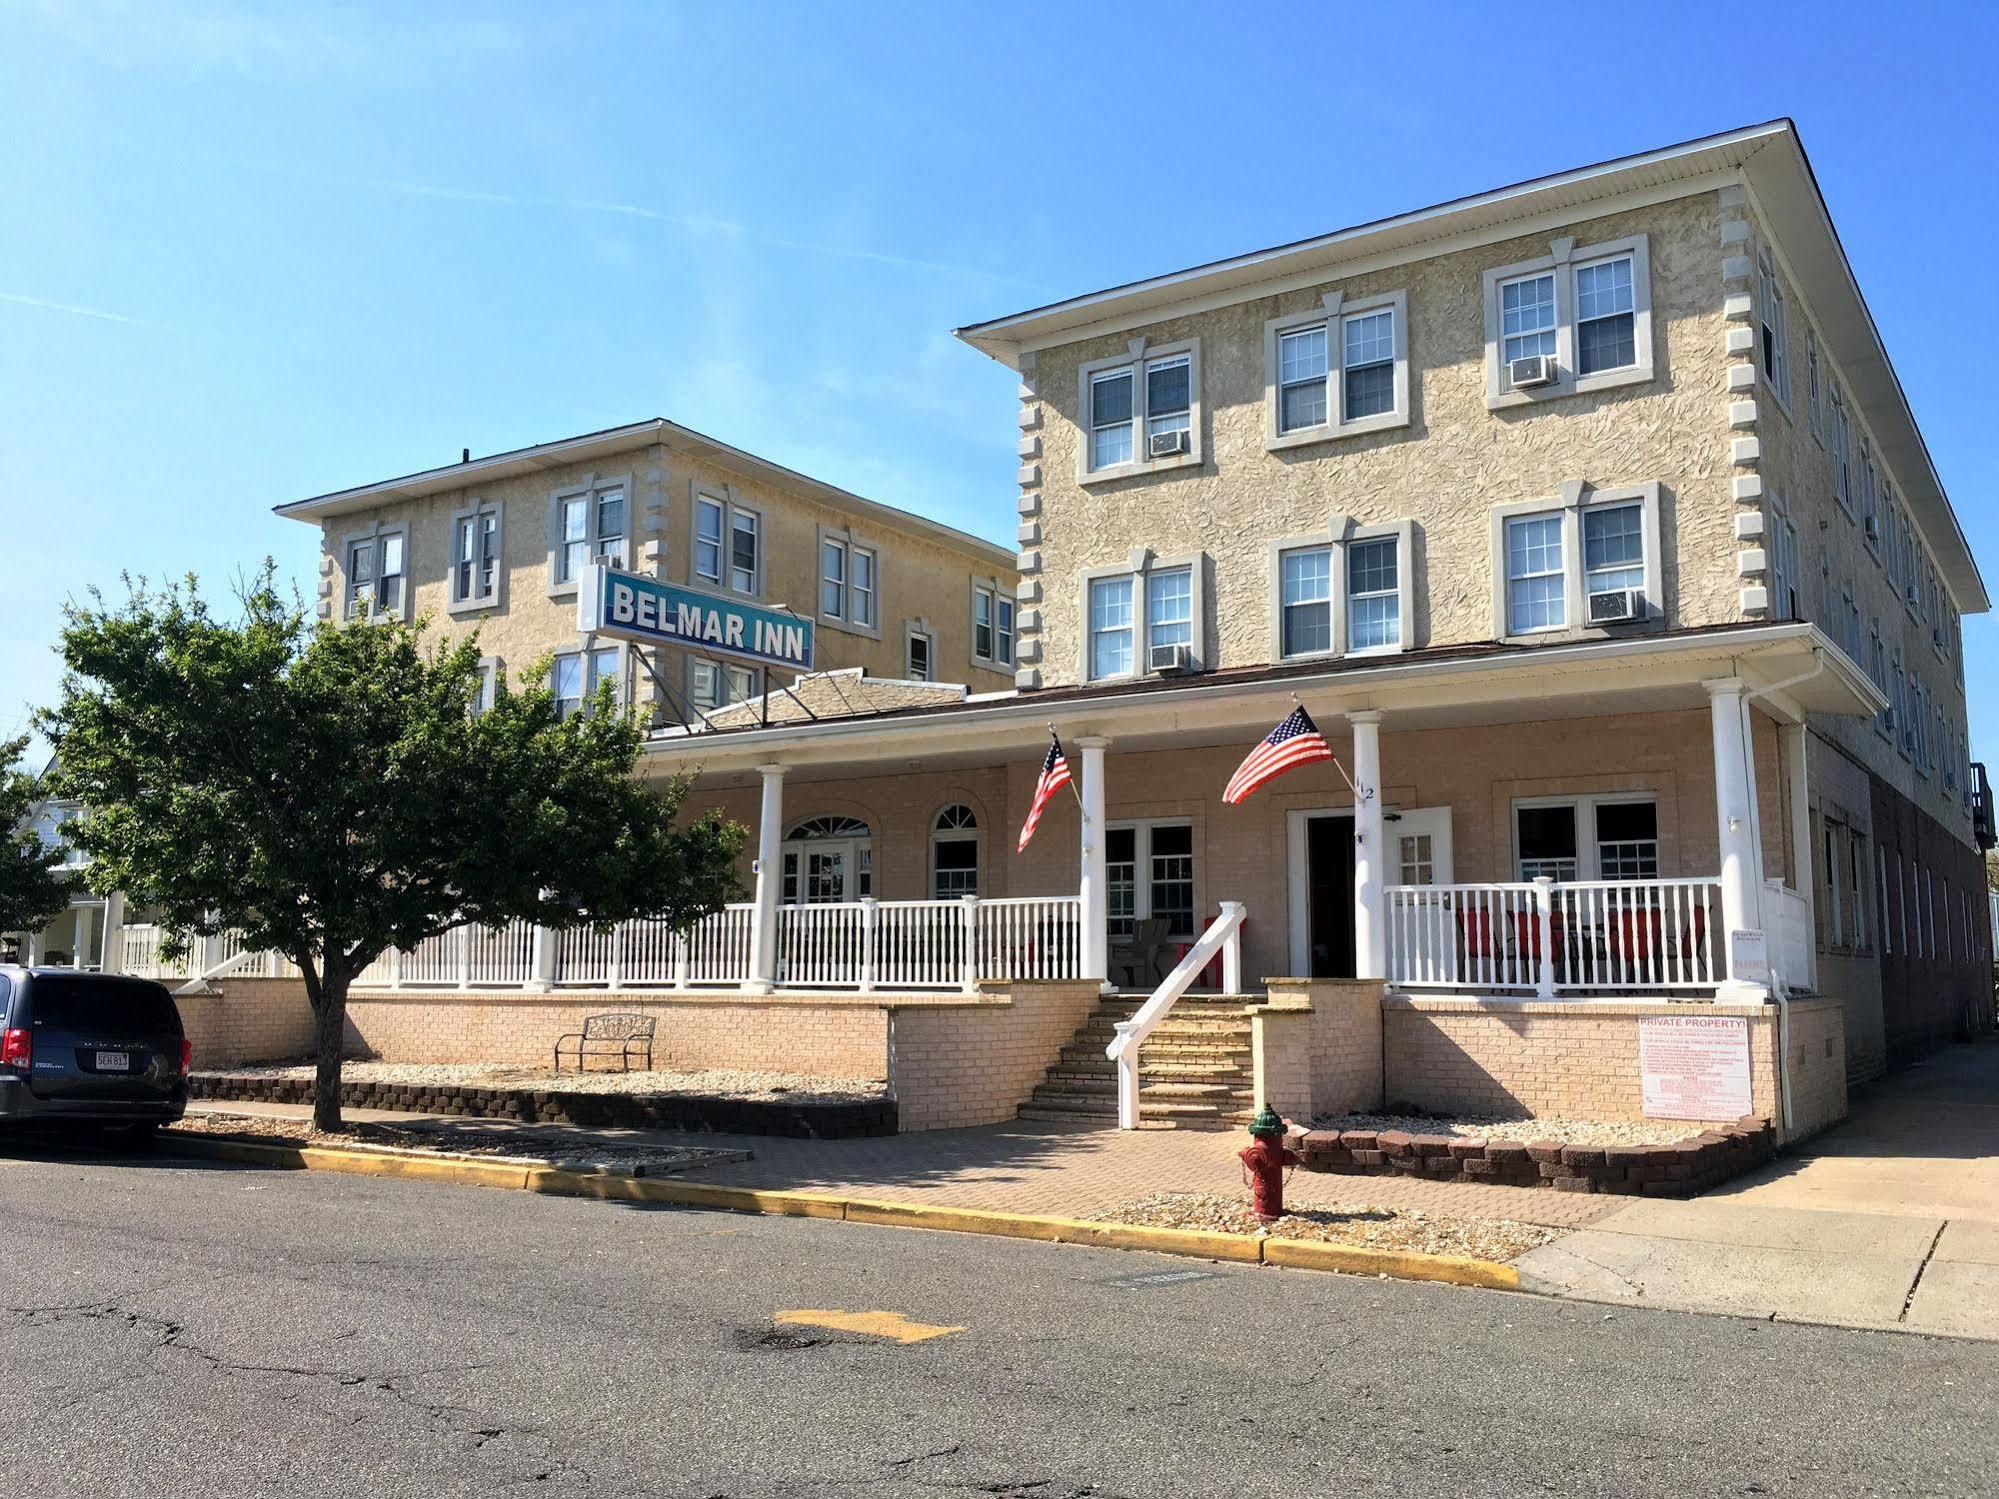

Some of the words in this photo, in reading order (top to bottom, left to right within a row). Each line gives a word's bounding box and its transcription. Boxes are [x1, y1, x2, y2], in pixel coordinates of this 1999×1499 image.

[613, 583, 744, 649] BELMAR
[754, 619, 804, 661] INN
[1640, 1017, 1682, 1027] PRIVATE
